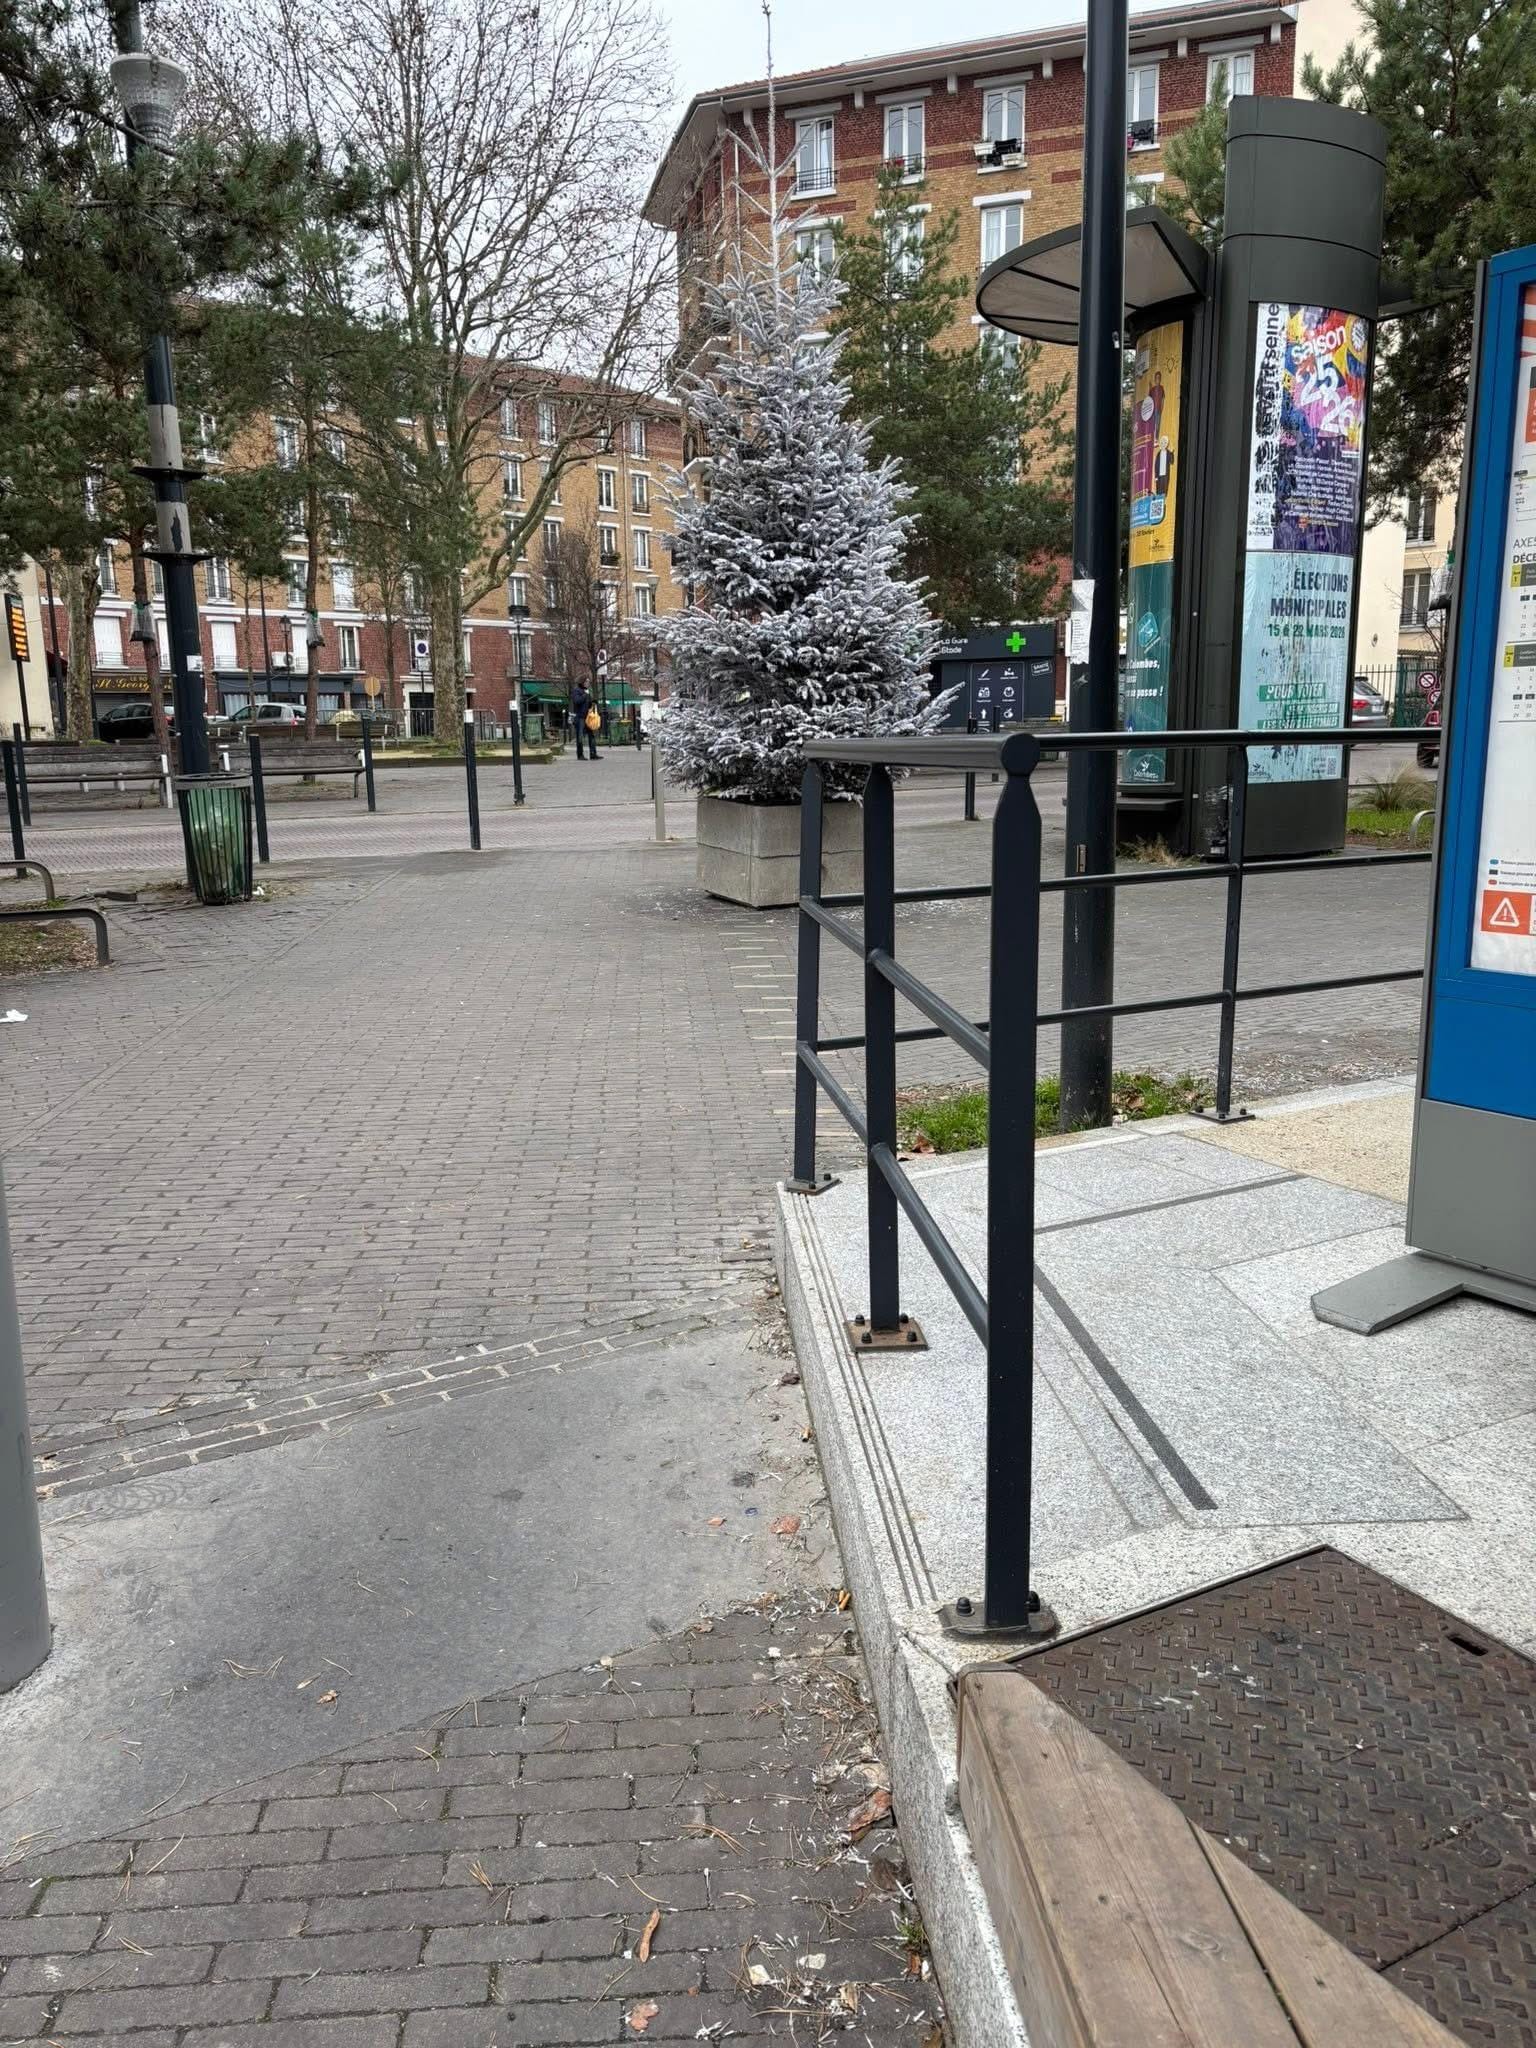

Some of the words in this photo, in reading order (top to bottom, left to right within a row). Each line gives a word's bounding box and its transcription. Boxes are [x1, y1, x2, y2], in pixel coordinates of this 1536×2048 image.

[1290, 324, 1346, 365] saison
[1295, 355, 1339, 406] 25
[1319, 386, 1357, 436] 26
[1293, 567, 1349, 593] ÉLECTIONS
[1270, 598, 1347, 620] MUNICIPALES
[1267, 624, 1280, 637] 15
[1306, 624, 1329, 638] MARS
